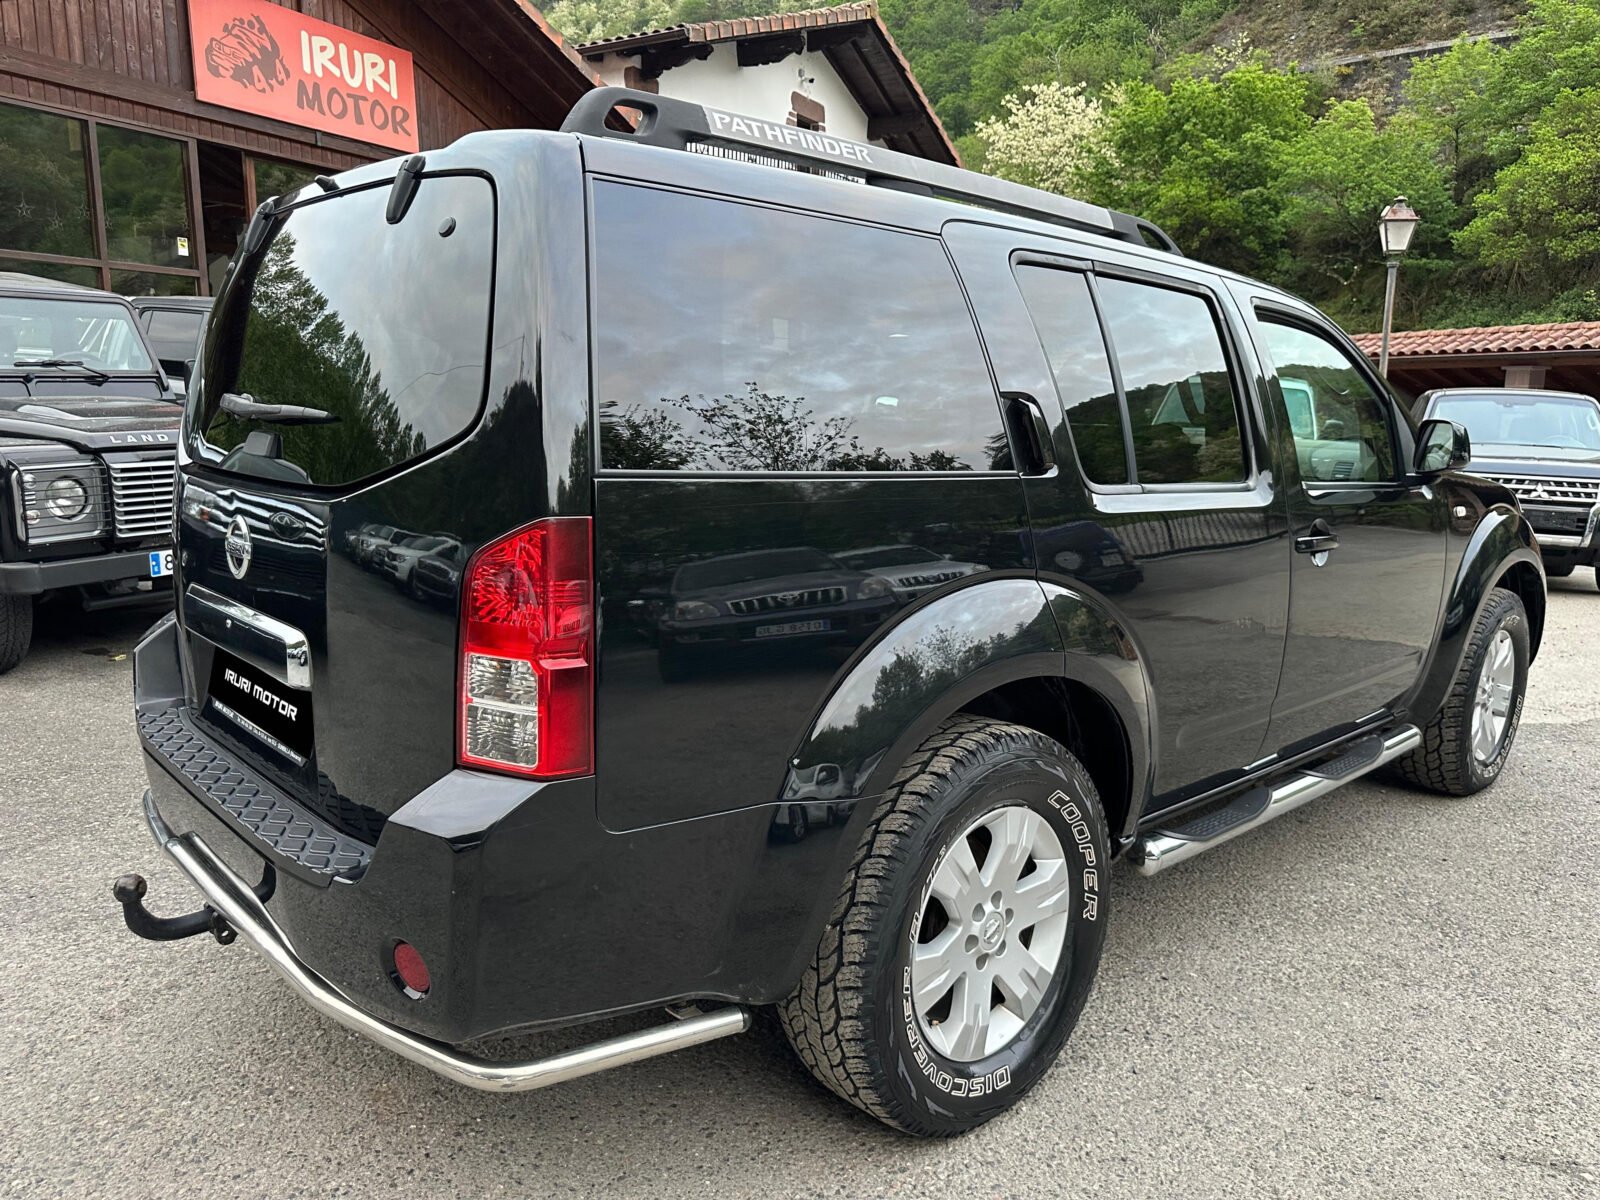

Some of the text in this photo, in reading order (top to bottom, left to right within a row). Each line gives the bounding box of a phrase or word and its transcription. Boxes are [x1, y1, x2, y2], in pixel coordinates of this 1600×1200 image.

[301, 30, 398, 100] IRURI
[296, 79, 412, 137] MOTOR
[712, 111, 874, 164] PATHFINDER
[109, 433, 169, 444] LAND
[165, 553, 174, 571] 8
[224, 668, 299, 722] IRURI MOTOR
[1047, 789, 1100, 922] COOPER
[902, 965, 1012, 1098] DISCOVERER
